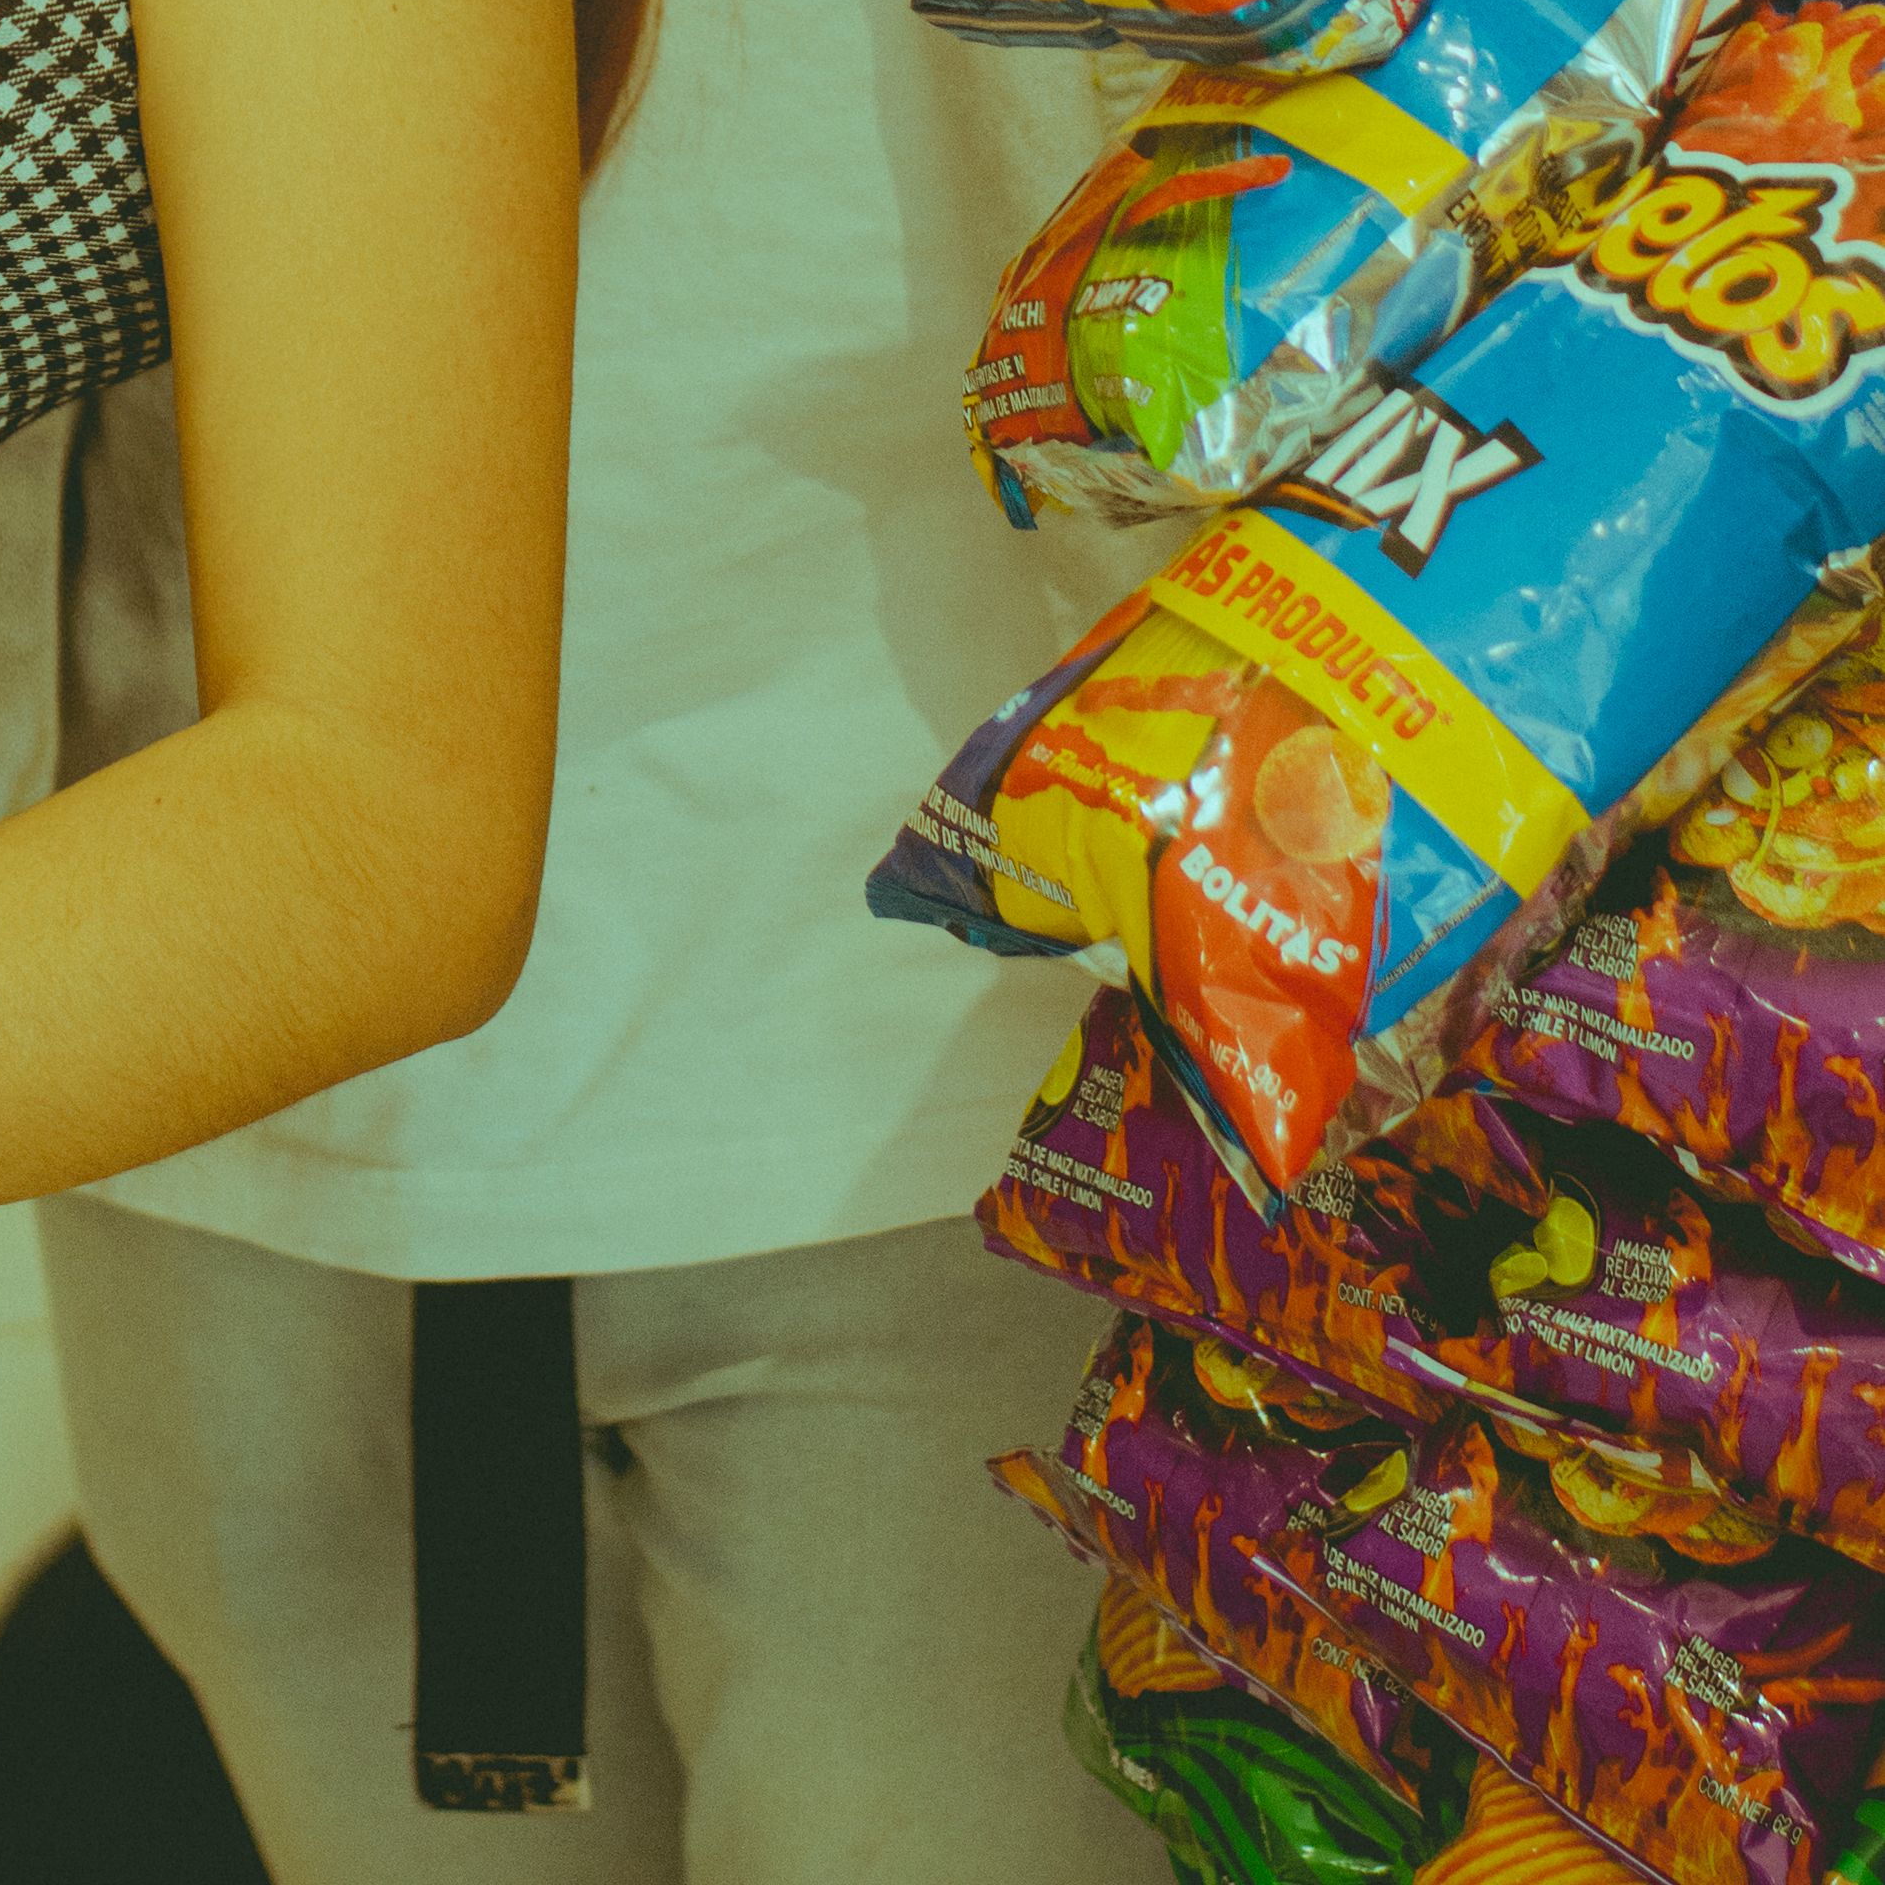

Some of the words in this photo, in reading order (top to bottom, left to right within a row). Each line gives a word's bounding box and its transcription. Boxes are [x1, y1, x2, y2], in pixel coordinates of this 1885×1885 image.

[1575, 926, 1639, 962] RELATIVA
[1568, 946, 1585, 968] AL
[1588, 950, 1635, 983] SABOR
[1521, 988, 1542, 1007] DE
[1581, 1005, 1696, 1062] NIXTAMALIZADO
[1521, 1010, 1566, 1040] CHILE
[1080, 1080, 1124, 1115] RELATIVA
[1071, 1099, 1086, 1120] AL
[1087, 1104, 1120, 1134] SABOR
[1305, 1190, 1355, 1220] SABOR
[1613, 1238, 1672, 1269] IMAGEN
[1605, 1256, 1673, 1289] RELATIVA
[1598, 1278, 1615, 1297] AL
[1618, 1281, 1669, 1305] SABOR
[1527, 1319, 1572, 1353] CHILE
[1529, 1302, 1554, 1319] DE
[1590, 1319, 1715, 1384] NIXTAMALIZADO
[1378, 1513, 1395, 1536] AL
[1397, 1521, 1445, 1561] SABOR
[1326, 1571, 1368, 1601] CHILE
[1380, 1577, 1486, 1649] NIXTAMALIZADO
[1690, 1634, 1744, 1679] IMAGEN
[1685, 1676, 1736, 1714] SABOR
[1739, 1792, 1773, 1828] NET.
[1773, 1813, 1794, 1837] 62
